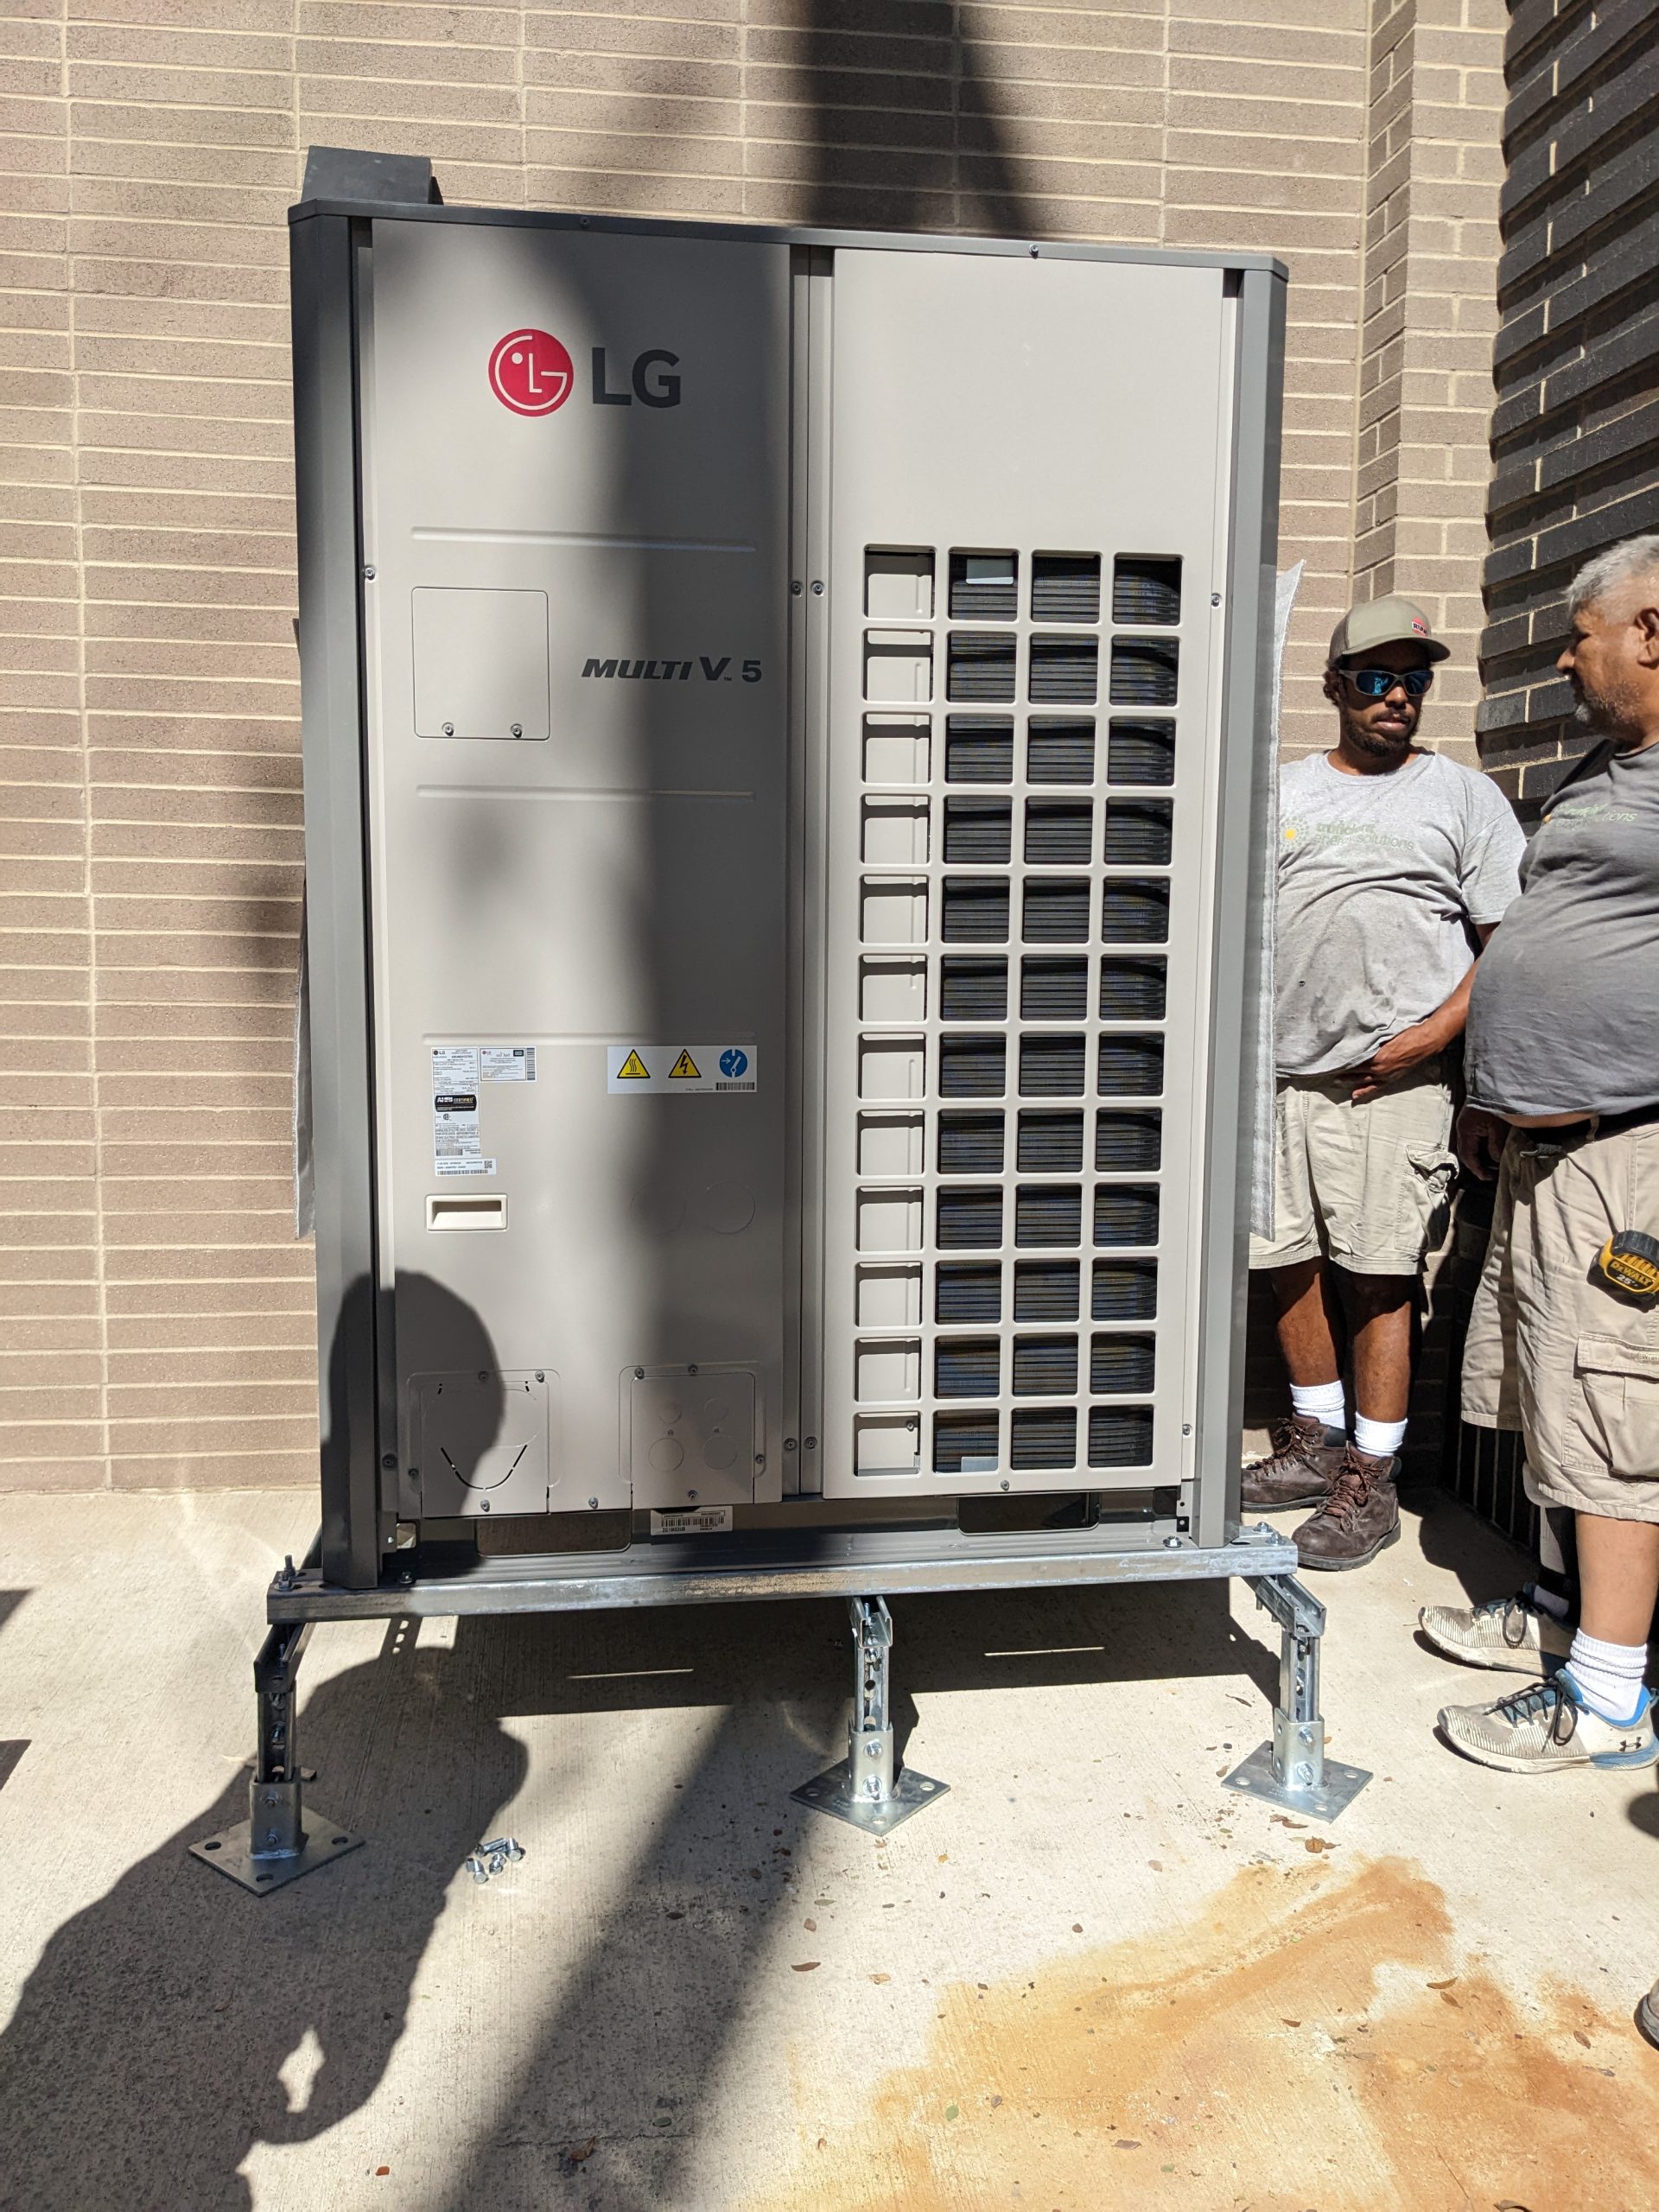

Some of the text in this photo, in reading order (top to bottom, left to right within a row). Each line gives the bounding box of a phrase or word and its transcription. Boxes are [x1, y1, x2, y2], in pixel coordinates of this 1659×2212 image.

[592, 346, 681, 409] LG
[581, 658, 694, 681] MULTI
[741, 659, 762, 683] 5
[1610, 1260, 1653, 1287] DEWALT
